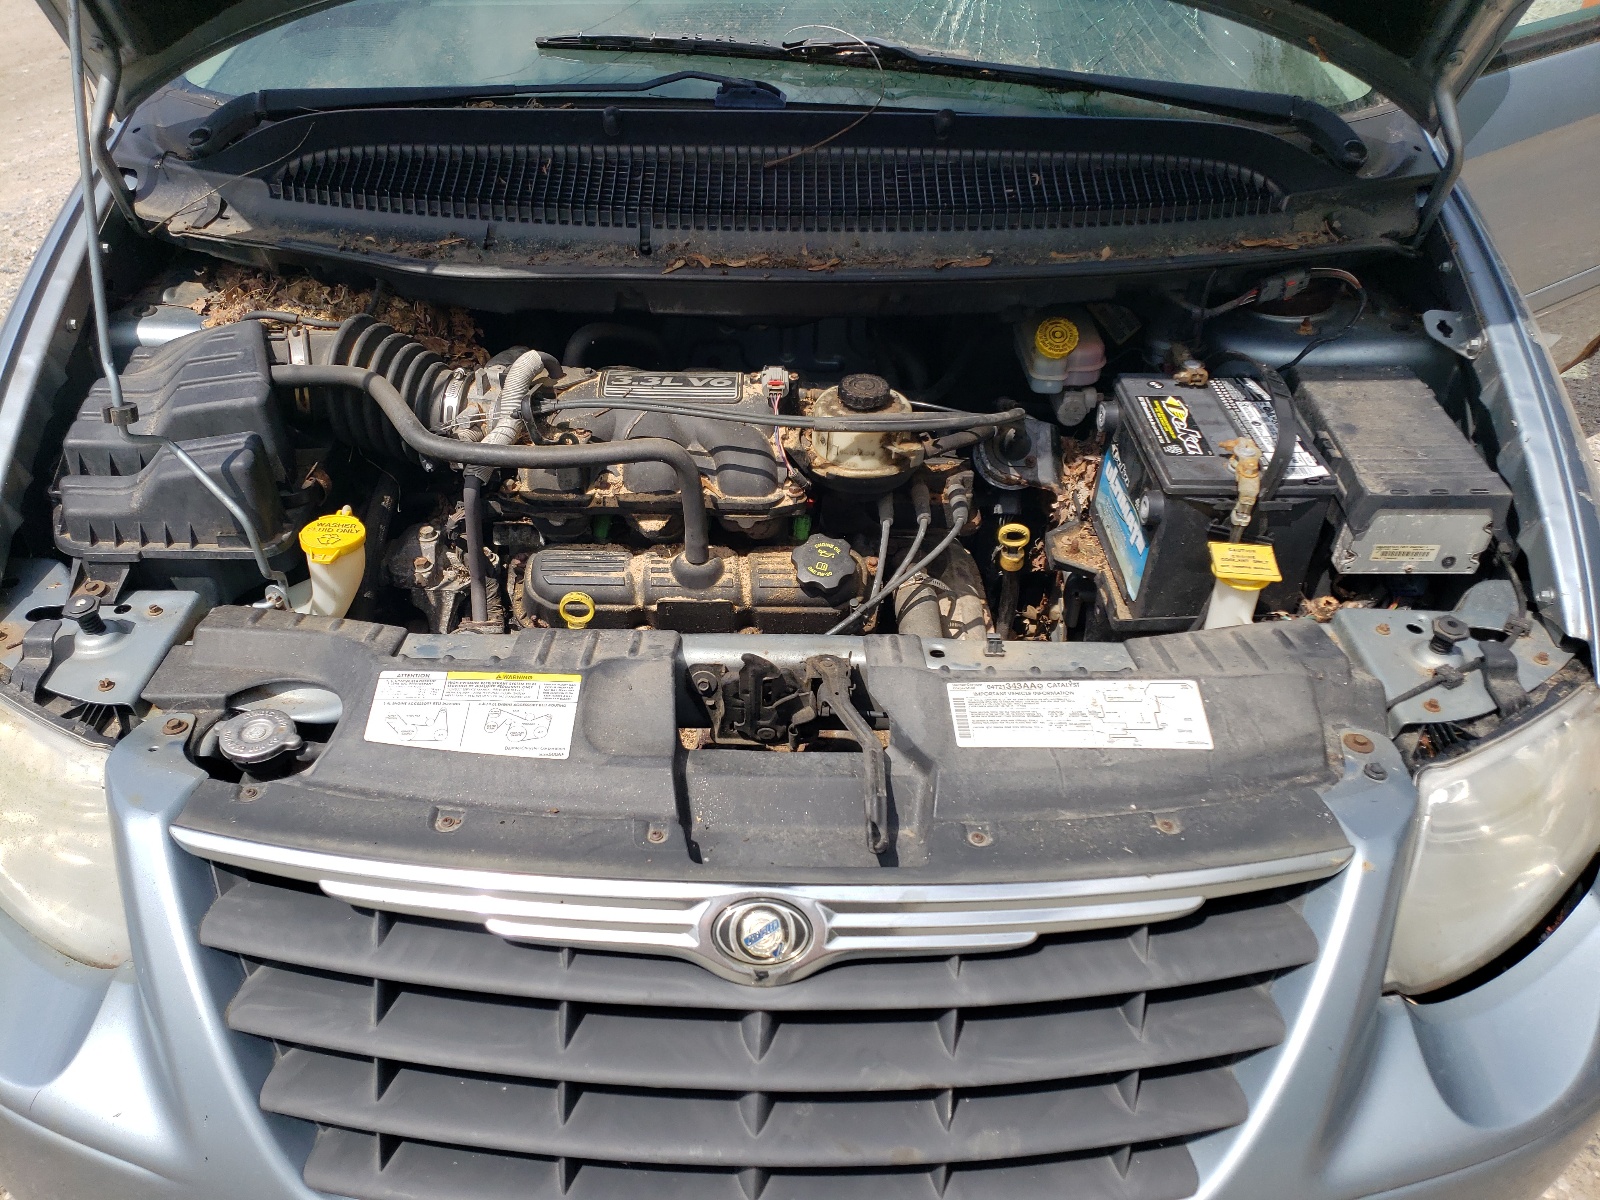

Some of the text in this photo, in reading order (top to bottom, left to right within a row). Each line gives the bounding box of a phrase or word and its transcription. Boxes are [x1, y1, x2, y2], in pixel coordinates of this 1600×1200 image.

[611, 375, 733, 387] 3.3L V6
[1161, 395, 1204, 456] Deka
